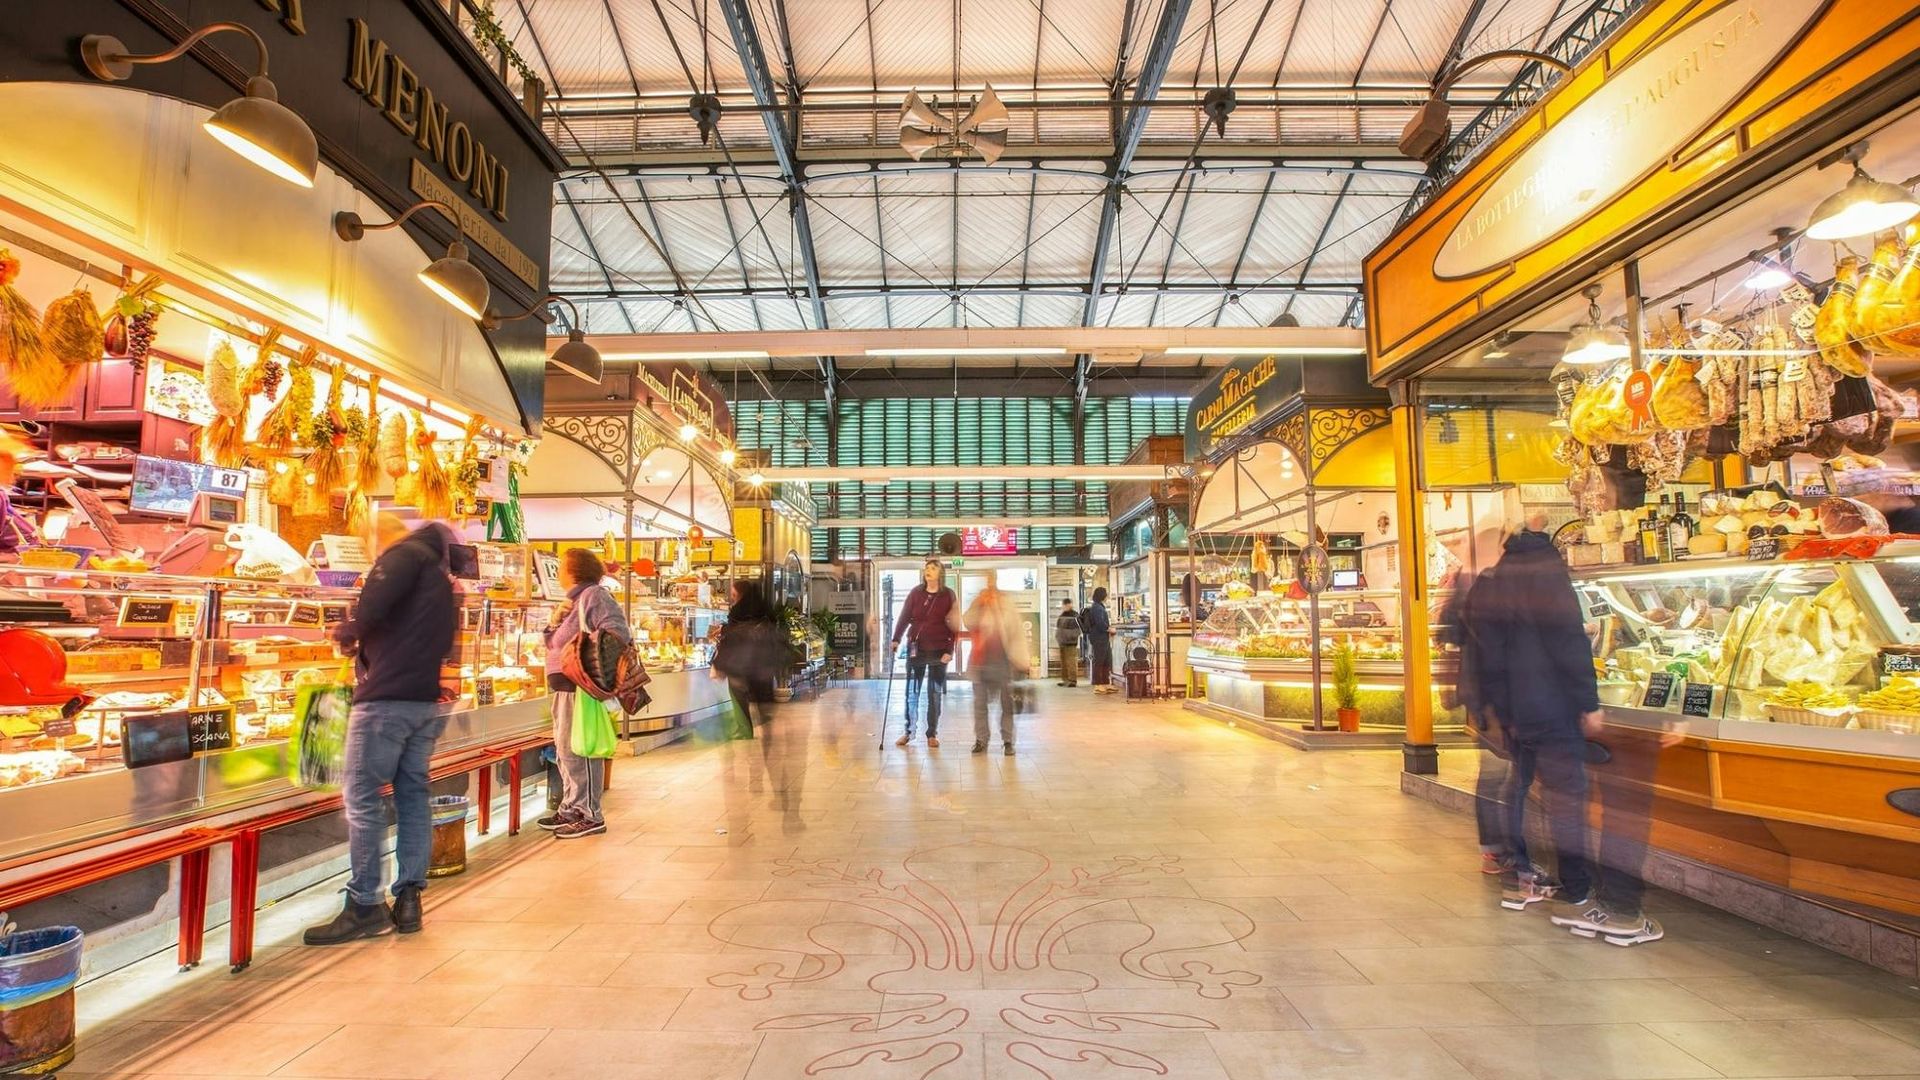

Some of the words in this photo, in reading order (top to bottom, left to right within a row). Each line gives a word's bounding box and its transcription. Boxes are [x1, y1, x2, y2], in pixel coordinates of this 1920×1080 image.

[349, 17, 509, 221] MENONI
[1196, 395, 1223, 432] CARNI
[1222, 354, 1277, 411] MAGICHE
[221, 473, 238, 488] 87
[189, 714, 223, 726] ARNE
[1583, 908, 1609, 925] N
